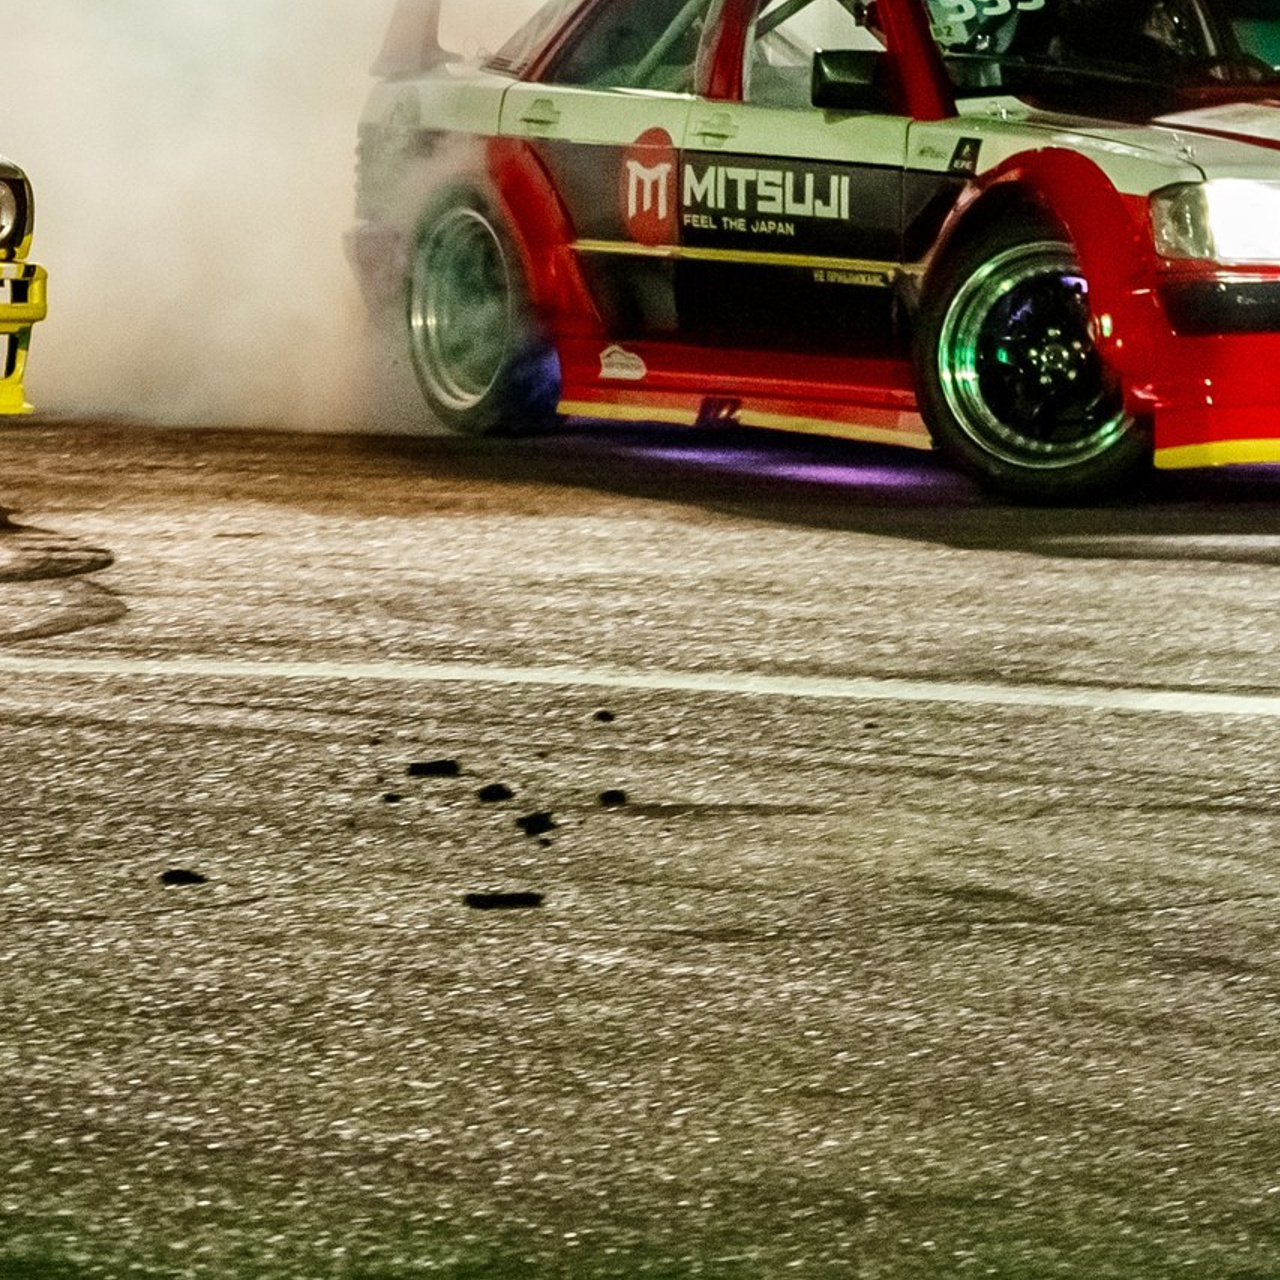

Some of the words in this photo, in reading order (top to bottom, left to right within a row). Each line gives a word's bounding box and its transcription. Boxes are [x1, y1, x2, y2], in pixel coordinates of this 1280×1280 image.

[683, 164, 850, 219] MITSUJI
[683, 214, 718, 230] FEEL
[721, 217, 747, 231] THE
[751, 221, 795, 236] JAPAN
